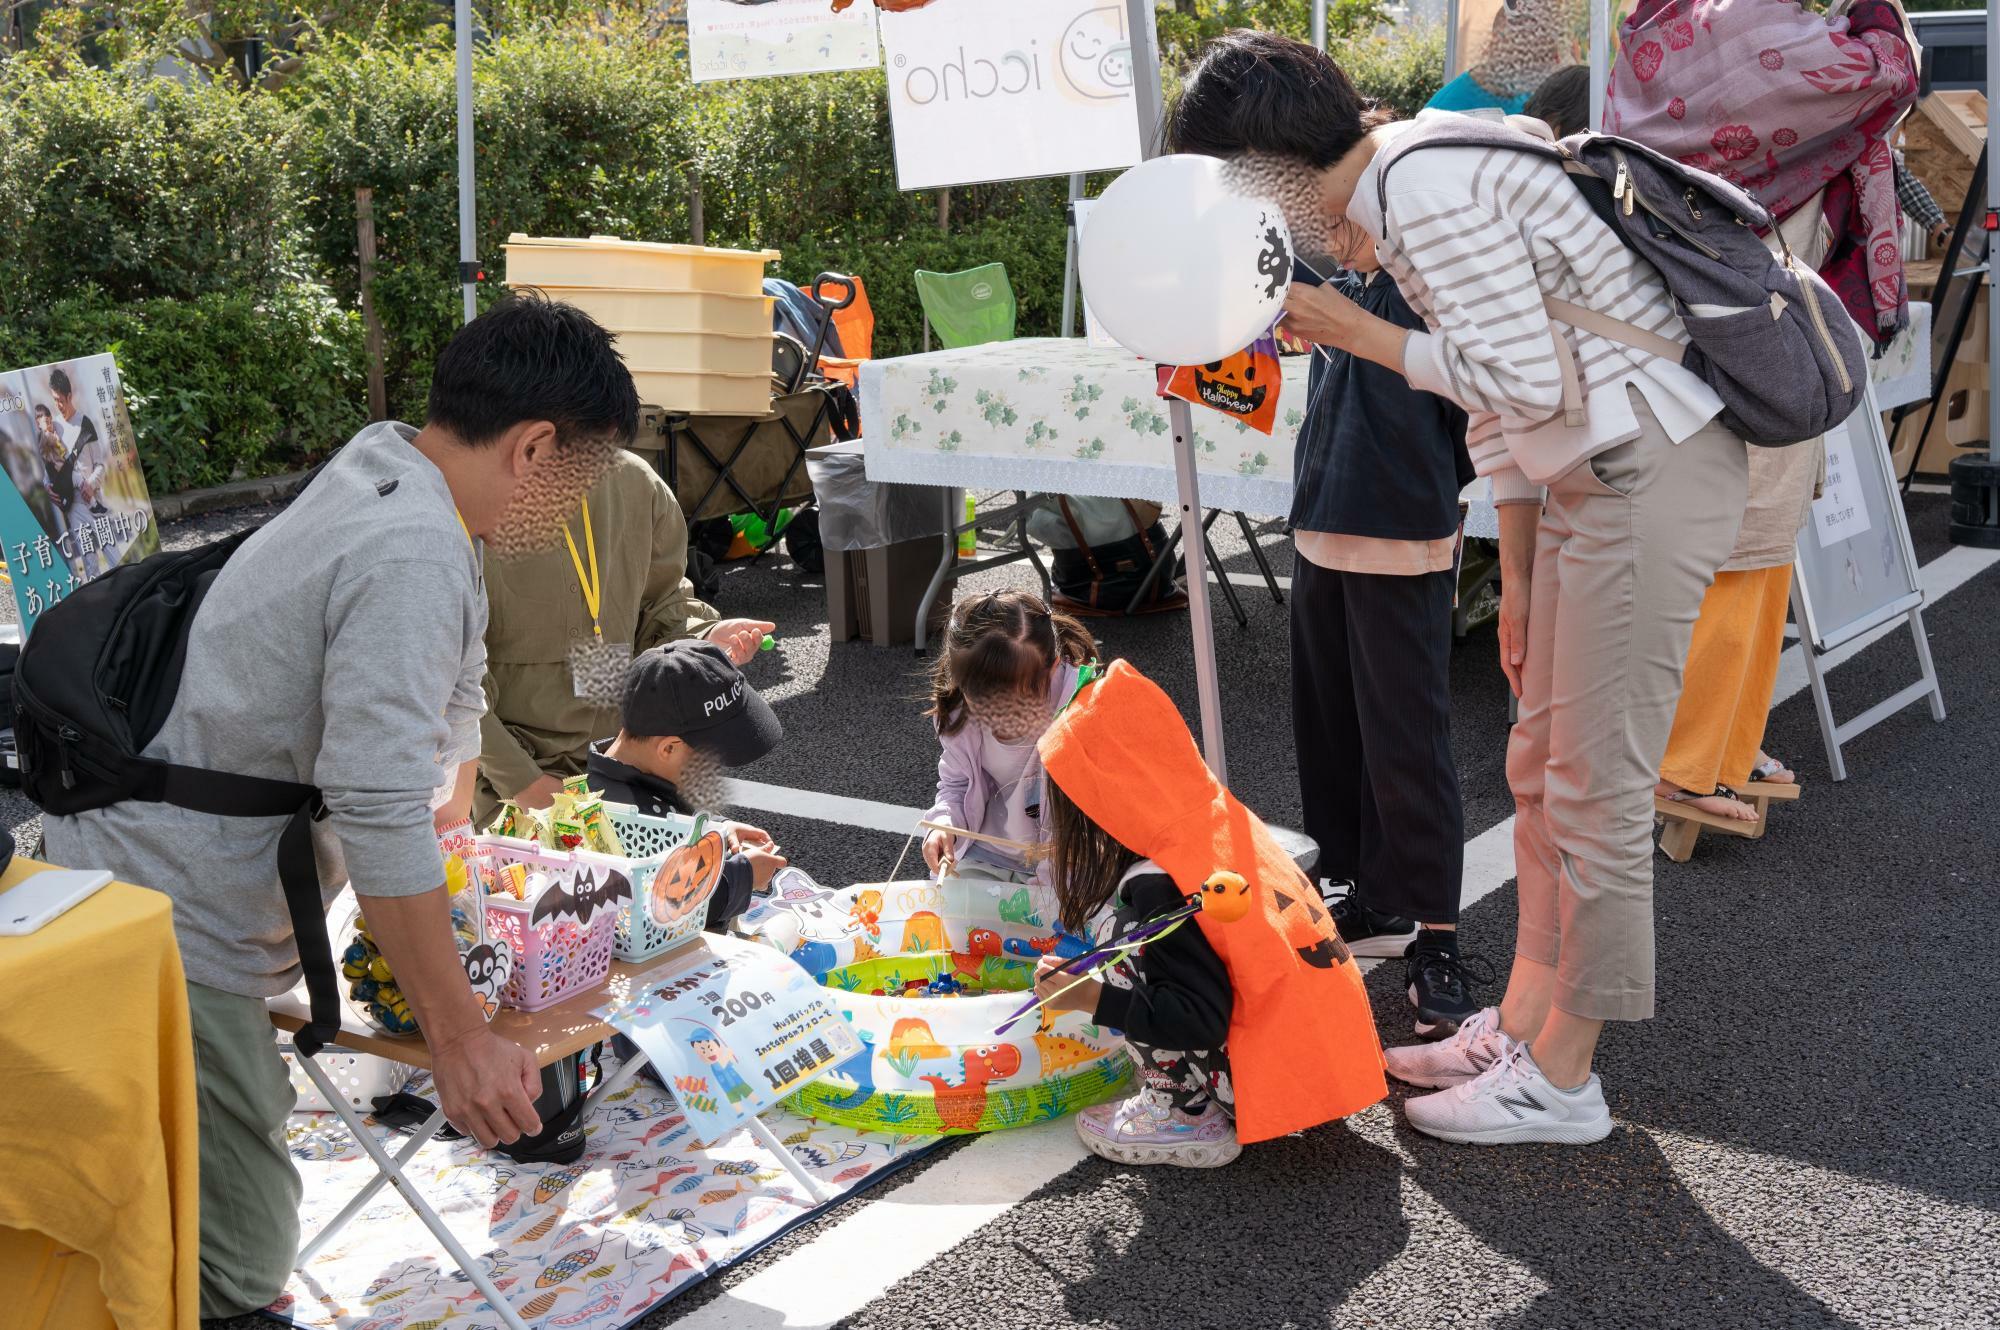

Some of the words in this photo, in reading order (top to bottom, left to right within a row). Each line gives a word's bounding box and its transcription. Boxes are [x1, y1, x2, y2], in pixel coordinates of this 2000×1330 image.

[1202, 386, 1254, 411] Halloween
[11, 508, 149, 576] 子育て奮闘中の
[697, 991, 721, 1006] 3回
[711, 991, 776, 1027] 200円
[763, 1037, 835, 1090] 1回増量
